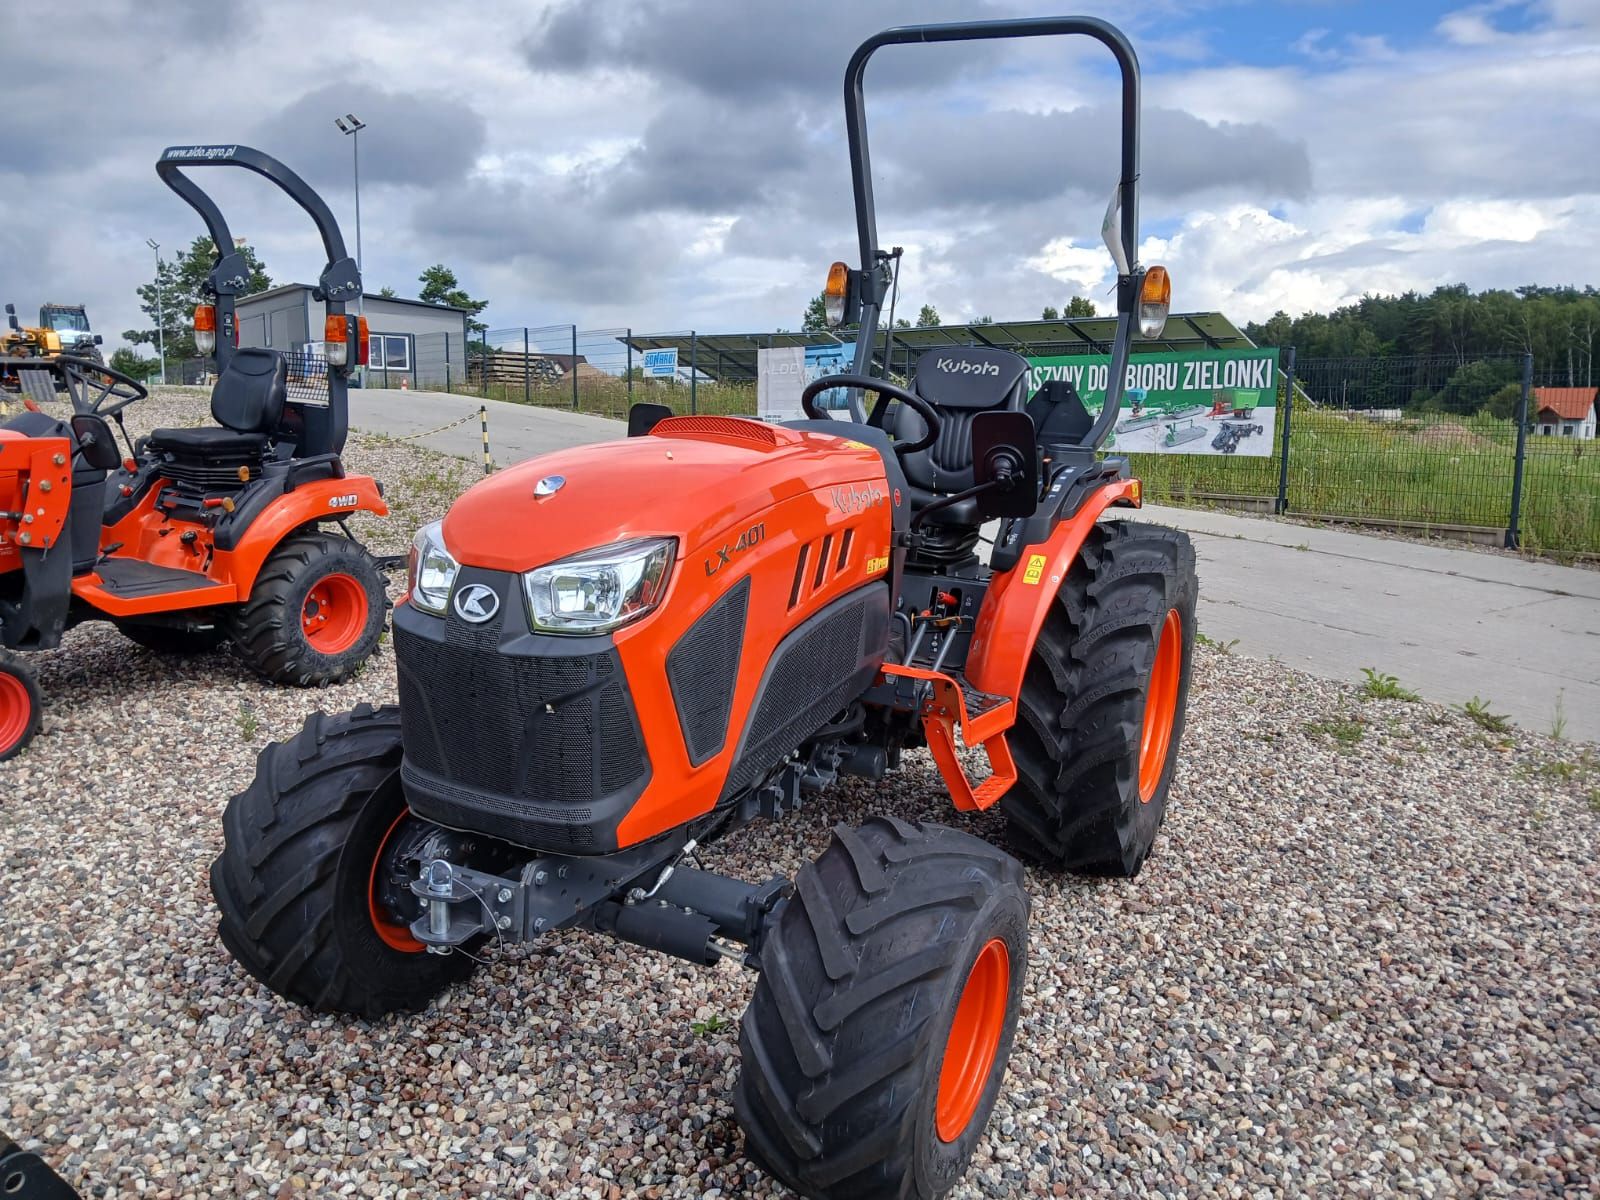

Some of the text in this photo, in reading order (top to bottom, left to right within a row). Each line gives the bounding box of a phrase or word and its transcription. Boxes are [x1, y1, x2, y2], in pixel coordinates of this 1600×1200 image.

[166, 146, 237, 159] www.aldo.agro.pl
[936, 358, 1000, 376] Kubota
[1025, 358, 1273, 392] ASZYNY DO BIORU ZIELONKI
[328, 494, 358, 508] 4WD
[831, 481, 883, 513] Kubota
[704, 521, 766, 577] LX-401
